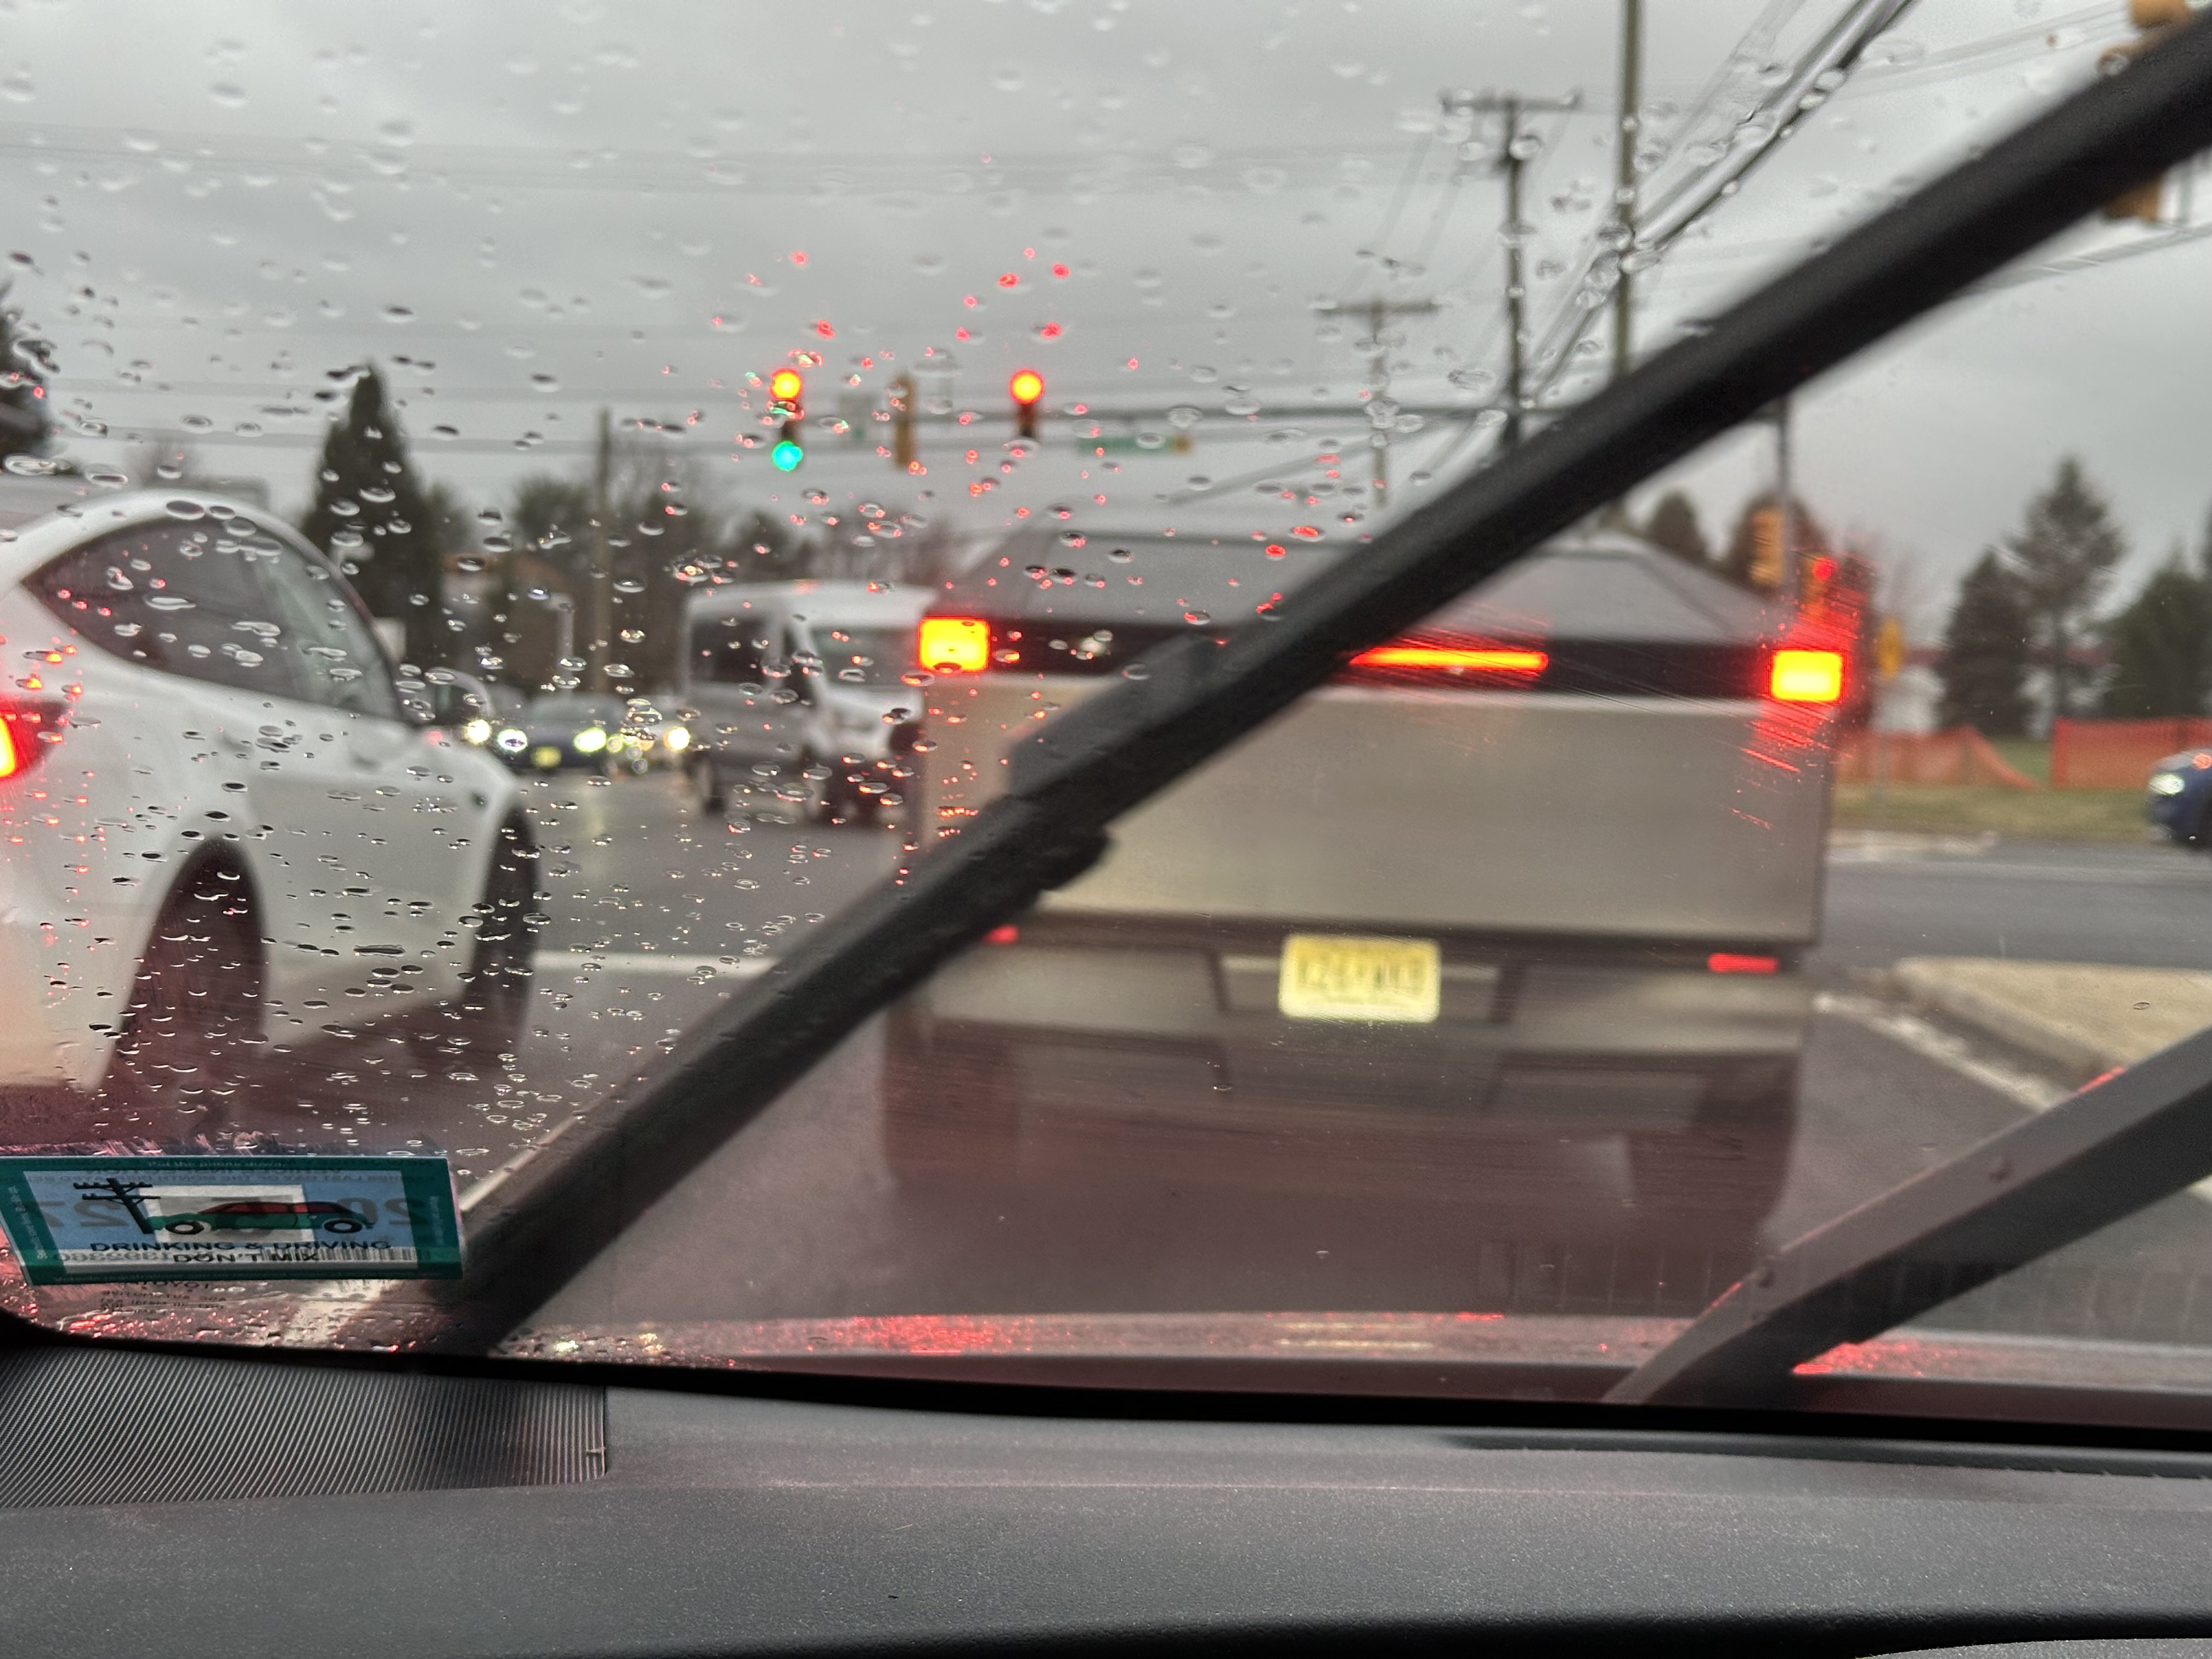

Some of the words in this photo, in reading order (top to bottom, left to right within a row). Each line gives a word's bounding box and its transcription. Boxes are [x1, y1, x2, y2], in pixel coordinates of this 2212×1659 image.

[91, 1242, 235, 1251] DRINKING
[273, 1240, 391, 1249] DRIVING
[173, 1252, 262, 1262] DON'T
[270, 1252, 319, 1262] MIX
